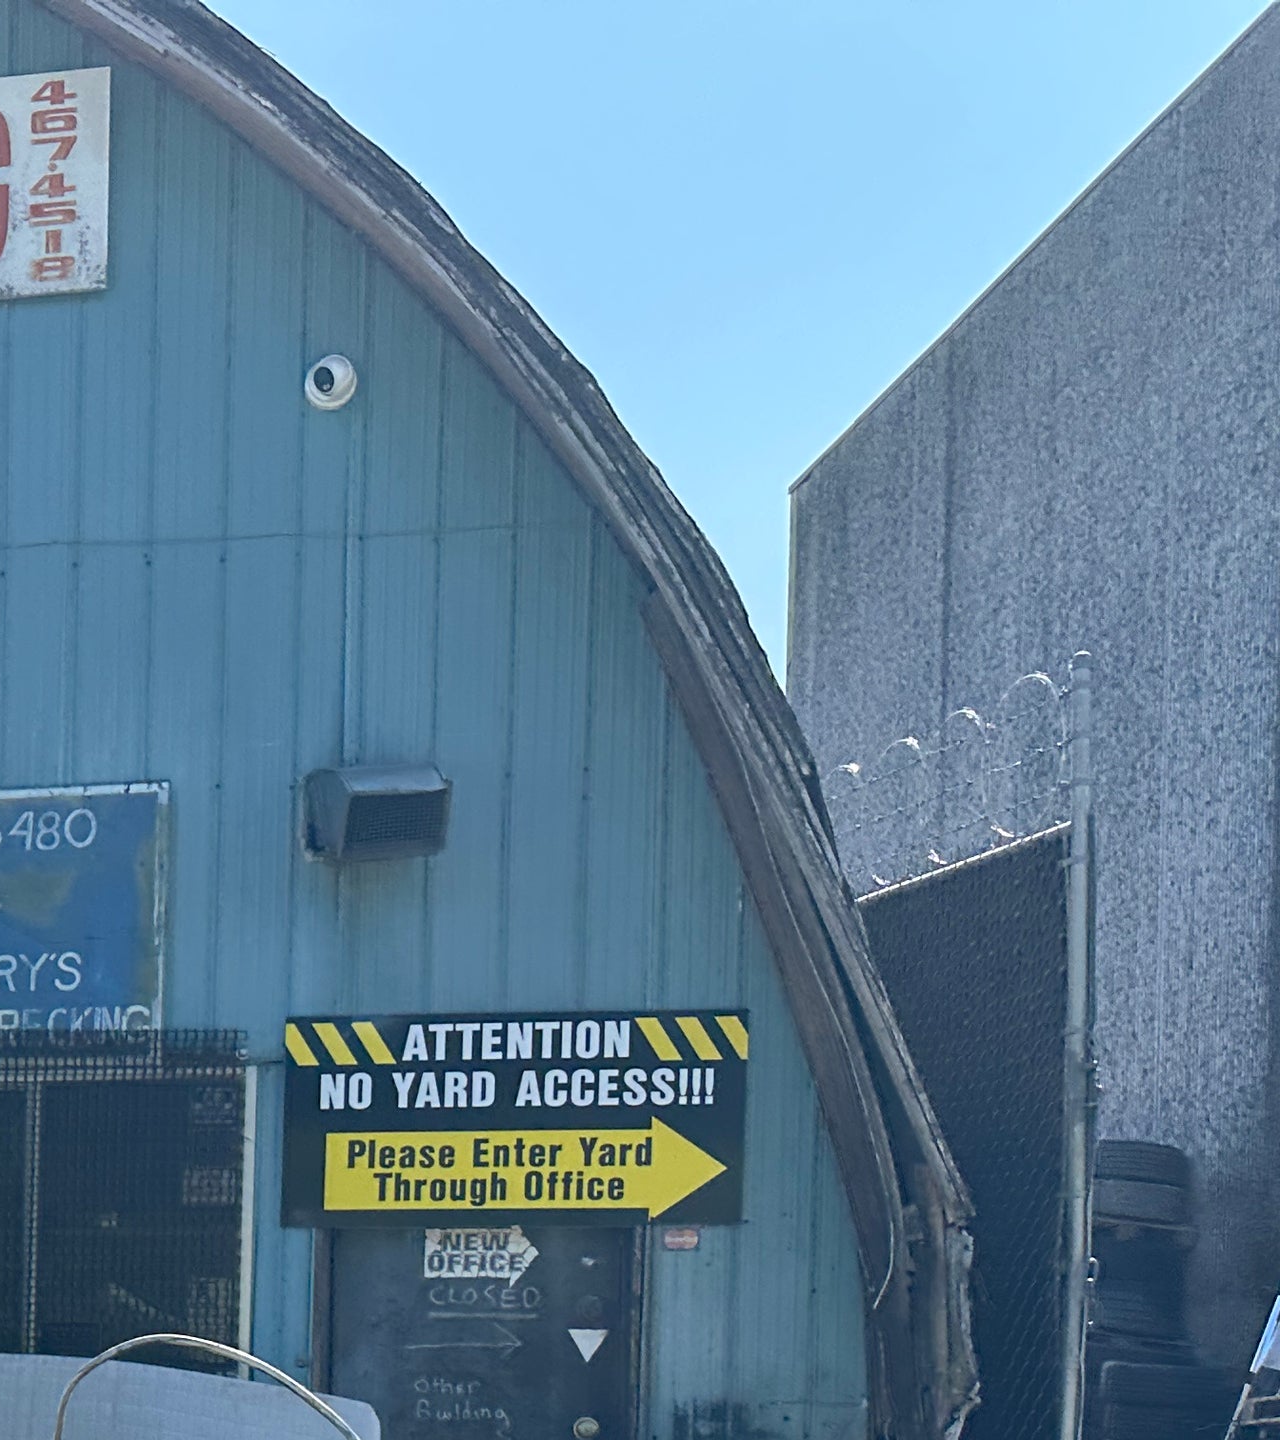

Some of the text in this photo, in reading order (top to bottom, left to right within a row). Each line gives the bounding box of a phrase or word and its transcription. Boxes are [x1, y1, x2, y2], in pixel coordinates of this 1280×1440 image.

[401, 1019, 631, 1062] ATTENTION
[319, 1067, 715, 1110] NO YARD ACCESS!!!
[347, 1136, 653, 1169] Please Enter Yard
[373, 1170, 626, 1206] Through Office
[440, 1231, 510, 1251] NEW
[427, 1251, 525, 1273] OFFICE
[429, 1284, 541, 1308] CLOSED
